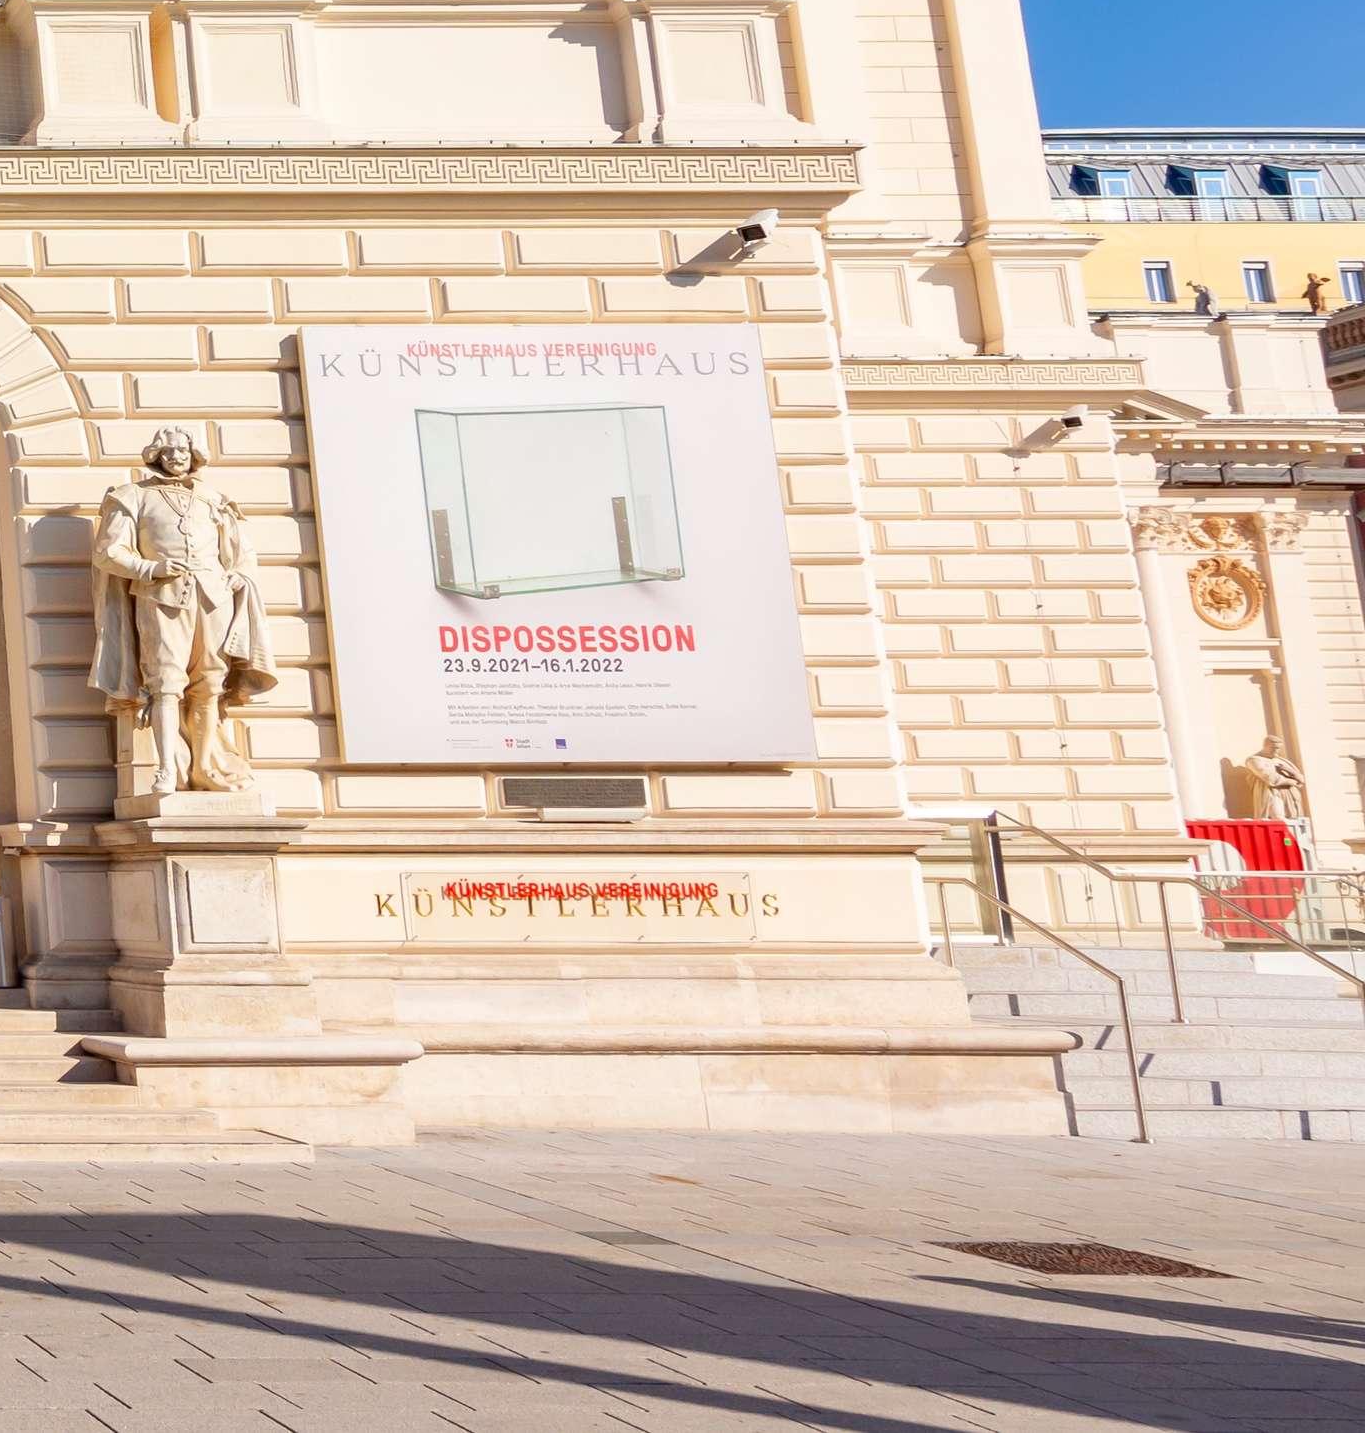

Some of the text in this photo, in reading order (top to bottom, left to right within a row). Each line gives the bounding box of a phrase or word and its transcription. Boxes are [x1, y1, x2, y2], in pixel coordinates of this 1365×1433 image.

[406, 341, 658, 358] KÜNSTLERHAUS VEREINIGUNG
[319, 349, 750, 378] KÜNSTLERHAUS
[438, 625, 697, 653] DISPOSSESSION
[446, 878, 719, 899] KÜNSTLERHAUS VEREINIGUNG
